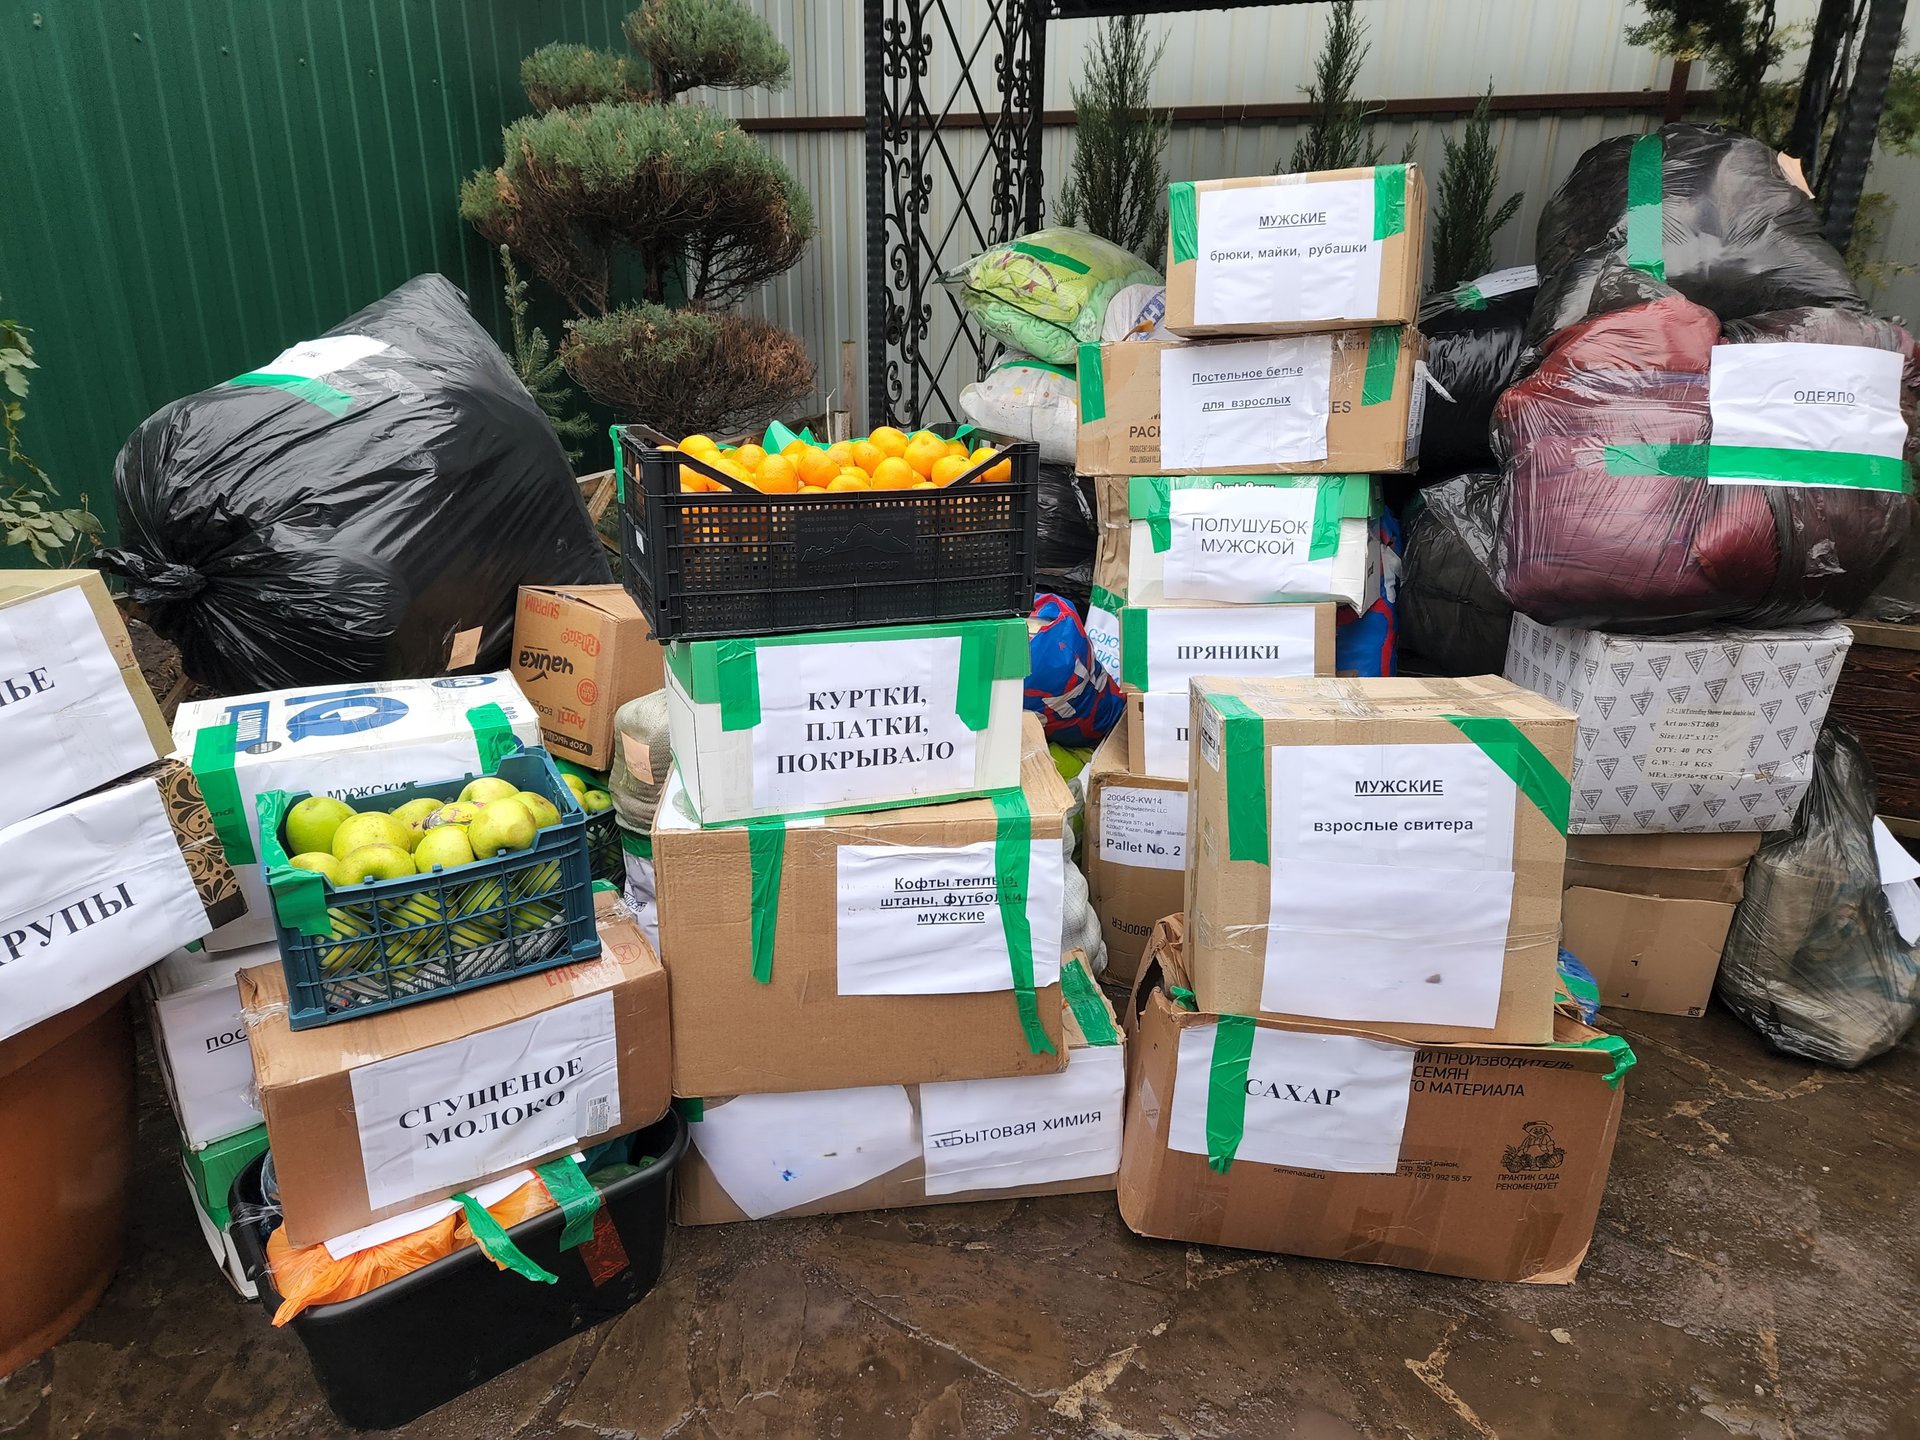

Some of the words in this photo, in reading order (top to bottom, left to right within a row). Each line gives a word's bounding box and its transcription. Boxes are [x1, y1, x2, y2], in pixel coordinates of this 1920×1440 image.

[1259, 211, 1327, 227] МУЖСКИЕ
[1210, 250, 1254, 263] брюки,
[1258, 246, 1301, 258] майки,
[1308, 242, 1368, 257] рубашки
[1191, 367, 1263, 383] Постельное
[1202, 400, 1225, 413] для
[1231, 394, 1291, 409] взрослых
[1793, 390, 1856, 405] ОДЕЯЛО
[1191, 517, 1308, 535] ПОЛУШУБОК
[1201, 537, 1294, 555] МУЖСКОЙ
[1176, 645, 1280, 660] ПРЯНИКИ
[808, 685, 928, 712] КУРТКИ,
[804, 714, 929, 742] ПЛАТКИ,
[776, 741, 955, 774] ПОКРЫВАЛО
[327, 780, 418, 801] МУЖСКИ
[1354, 779, 1444, 795] МУЖСКИЕ
[1106, 793, 1163, 805] 200452-KW14
[1313, 820, 1398, 834] взрослые
[1403, 819, 1473, 834] свитера
[1106, 838, 1143, 854] Pallet
[1146, 843, 1170, 856] No.
[1173, 845, 1182, 857] 2
[894, 877, 950, 892] Кофты
[880, 896, 939, 908] штаны,
[0, 881, 138, 967] РУПЫ
[917, 910, 985, 925] мужские
[1436, 1051, 1574, 1070] ПРОИЗВОДИТЕЛЬ
[1413, 1066, 1469, 1081] СЕМЯН
[398, 1056, 584, 1130] СГУЩЕНОЕ
[1243, 1078, 1341, 1106] САХАР
[1429, 1082, 1525, 1097] МАТЕРИАЛА
[424, 1090, 566, 1151] МОЛОКО
[1041, 1110, 1101, 1132] химия
[1273, 1166, 1326, 1181] semenasad.ru
[1497, 1173, 1537, 1181] ПРАКТИК
[1538, 1172, 1561, 1182] САДА
[1495, 1181, 1560, 1192] РЕКОМЕНДУЕТ
